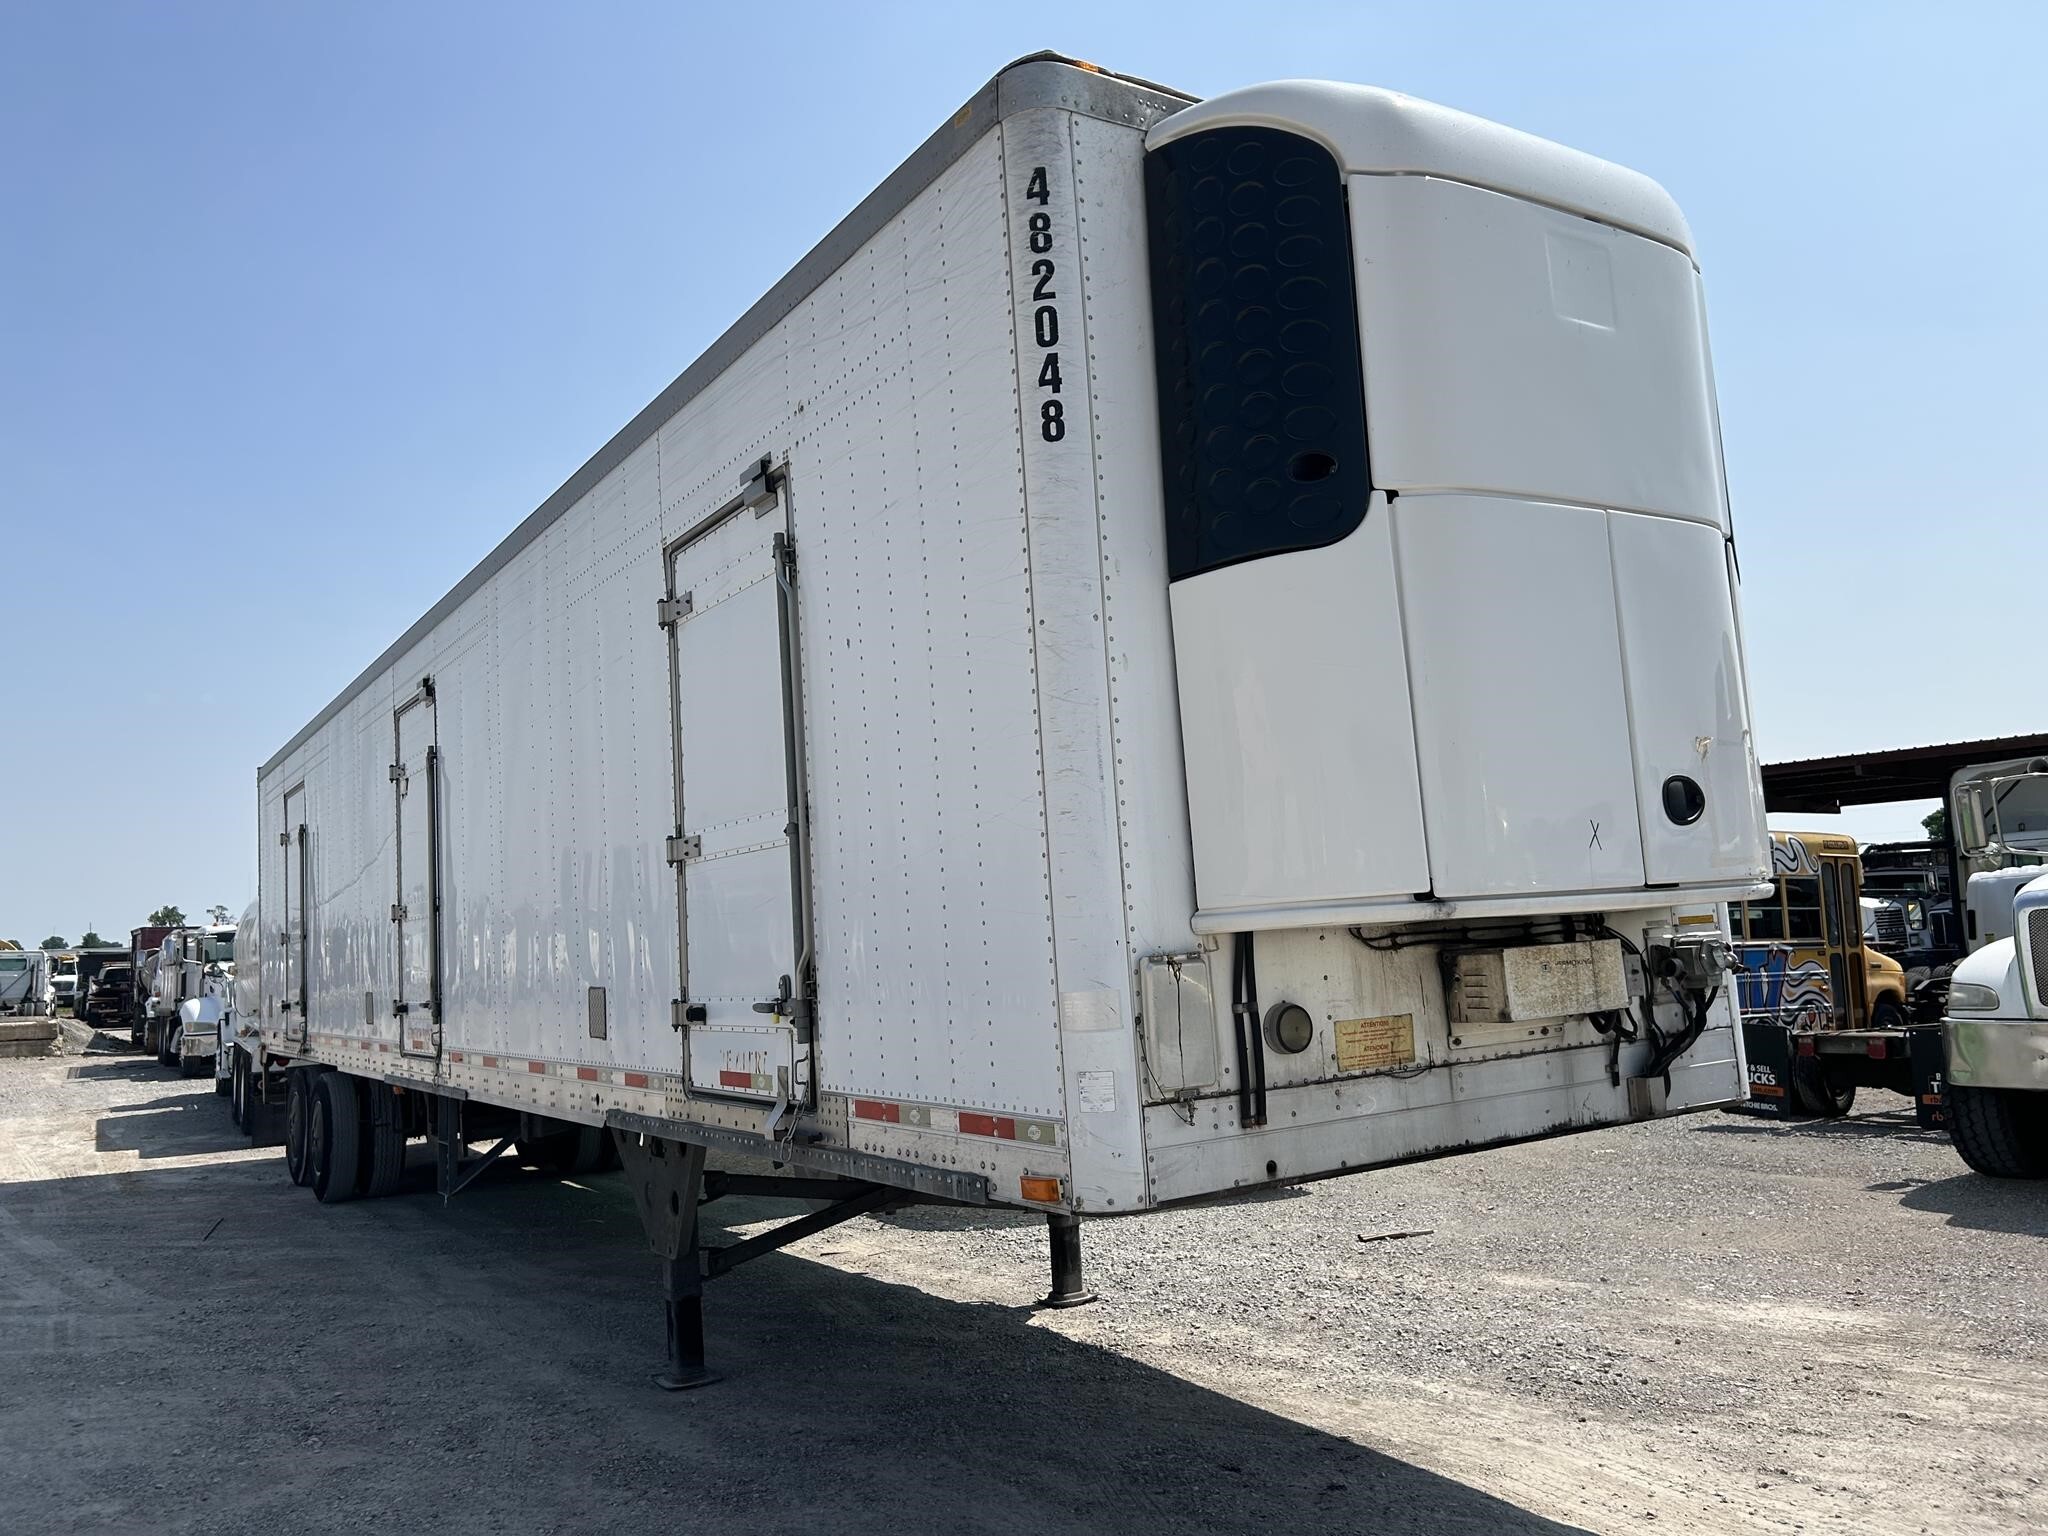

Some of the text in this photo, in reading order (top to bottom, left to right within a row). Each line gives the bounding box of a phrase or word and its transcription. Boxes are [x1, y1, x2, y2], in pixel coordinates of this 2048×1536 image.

[1026, 166, 1065, 443] 482048
[1878, 927, 1905, 935] MACK
[1756, 1065, 1771, 1073] SELL
